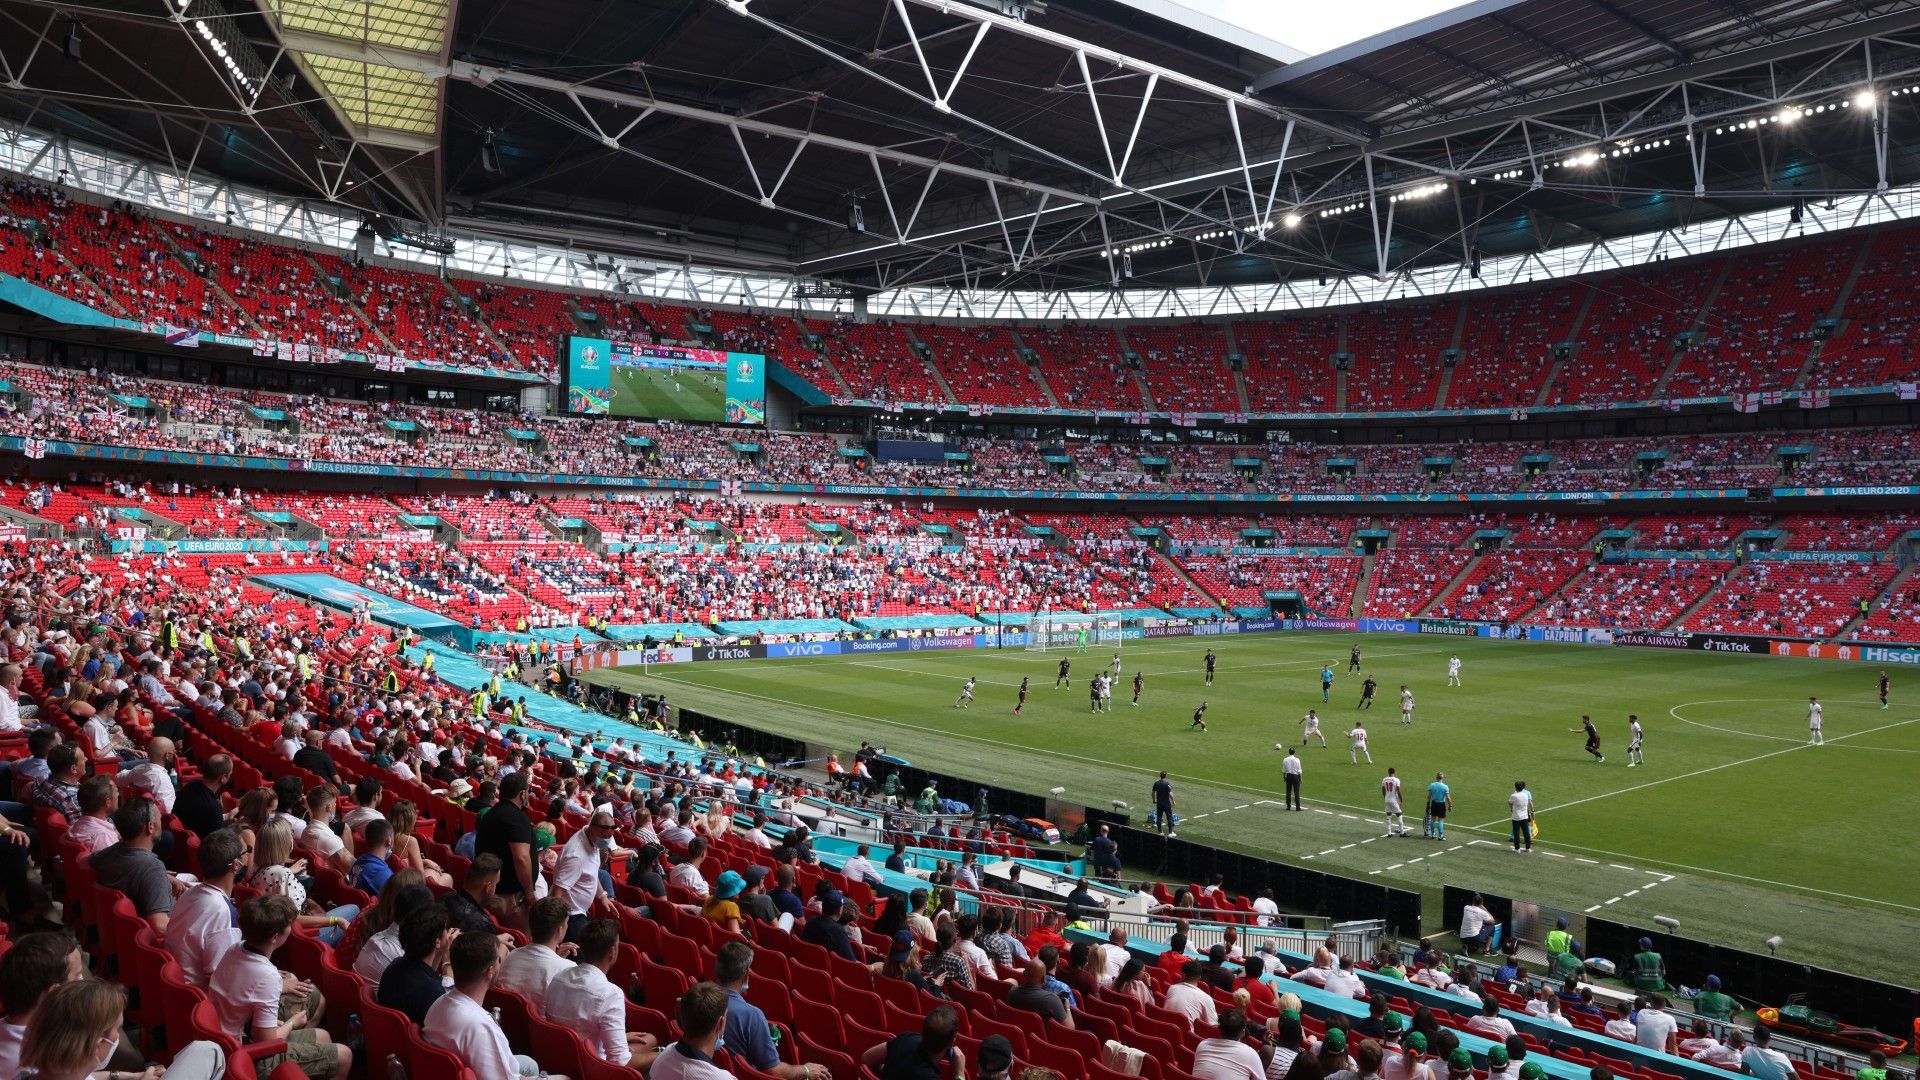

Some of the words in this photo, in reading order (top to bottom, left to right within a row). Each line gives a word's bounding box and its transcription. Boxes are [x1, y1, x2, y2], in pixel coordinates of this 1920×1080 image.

[311, 462, 333, 472] UEFA
[334, 464, 357, 474] EURO
[358, 465, 380, 475] 2020
[601, 476, 633, 486] LONDON
[869, 487, 887, 495] 2020
[1831, 488, 1857, 496] UEFA
[1857, 487, 1884, 495] EURO
[1884, 486, 1910, 495] 2020
[184, 541, 204, 551] UEFA
[204, 541, 224, 551] EURO
[224, 541, 244, 551] 2020
[1789, 552, 1812, 560] UEFA
[1835, 552, 1859, 561] 2020
[1193, 623, 1220, 635] GAZPROM
[1246, 622, 1275, 630] Booking.com
[1305, 620, 1356, 629] Volkswagen
[1374, 621, 1405, 631] vivo
[1421, 624, 1466, 635] Heineken
[1095, 629, 1140, 641] Hisense
[1143, 628, 1165, 637] QATAR
[1166, 625, 1193, 635] AIRWAYS
[1544, 630, 1583, 642] GAZPROM
[853, 641, 898, 651] Booking.com
[923, 637, 972, 648] Volkswagen
[1645, 636, 1688, 647] AIRWAYS
[1715, 641, 1750, 652] TikTok
[718, 648, 751, 659] TikTok
[784, 643, 824, 656] vivo
[640, 649, 673, 663] FedEx
[366, 713, 375, 724] 6
[1357, 732, 1364, 741] 12
